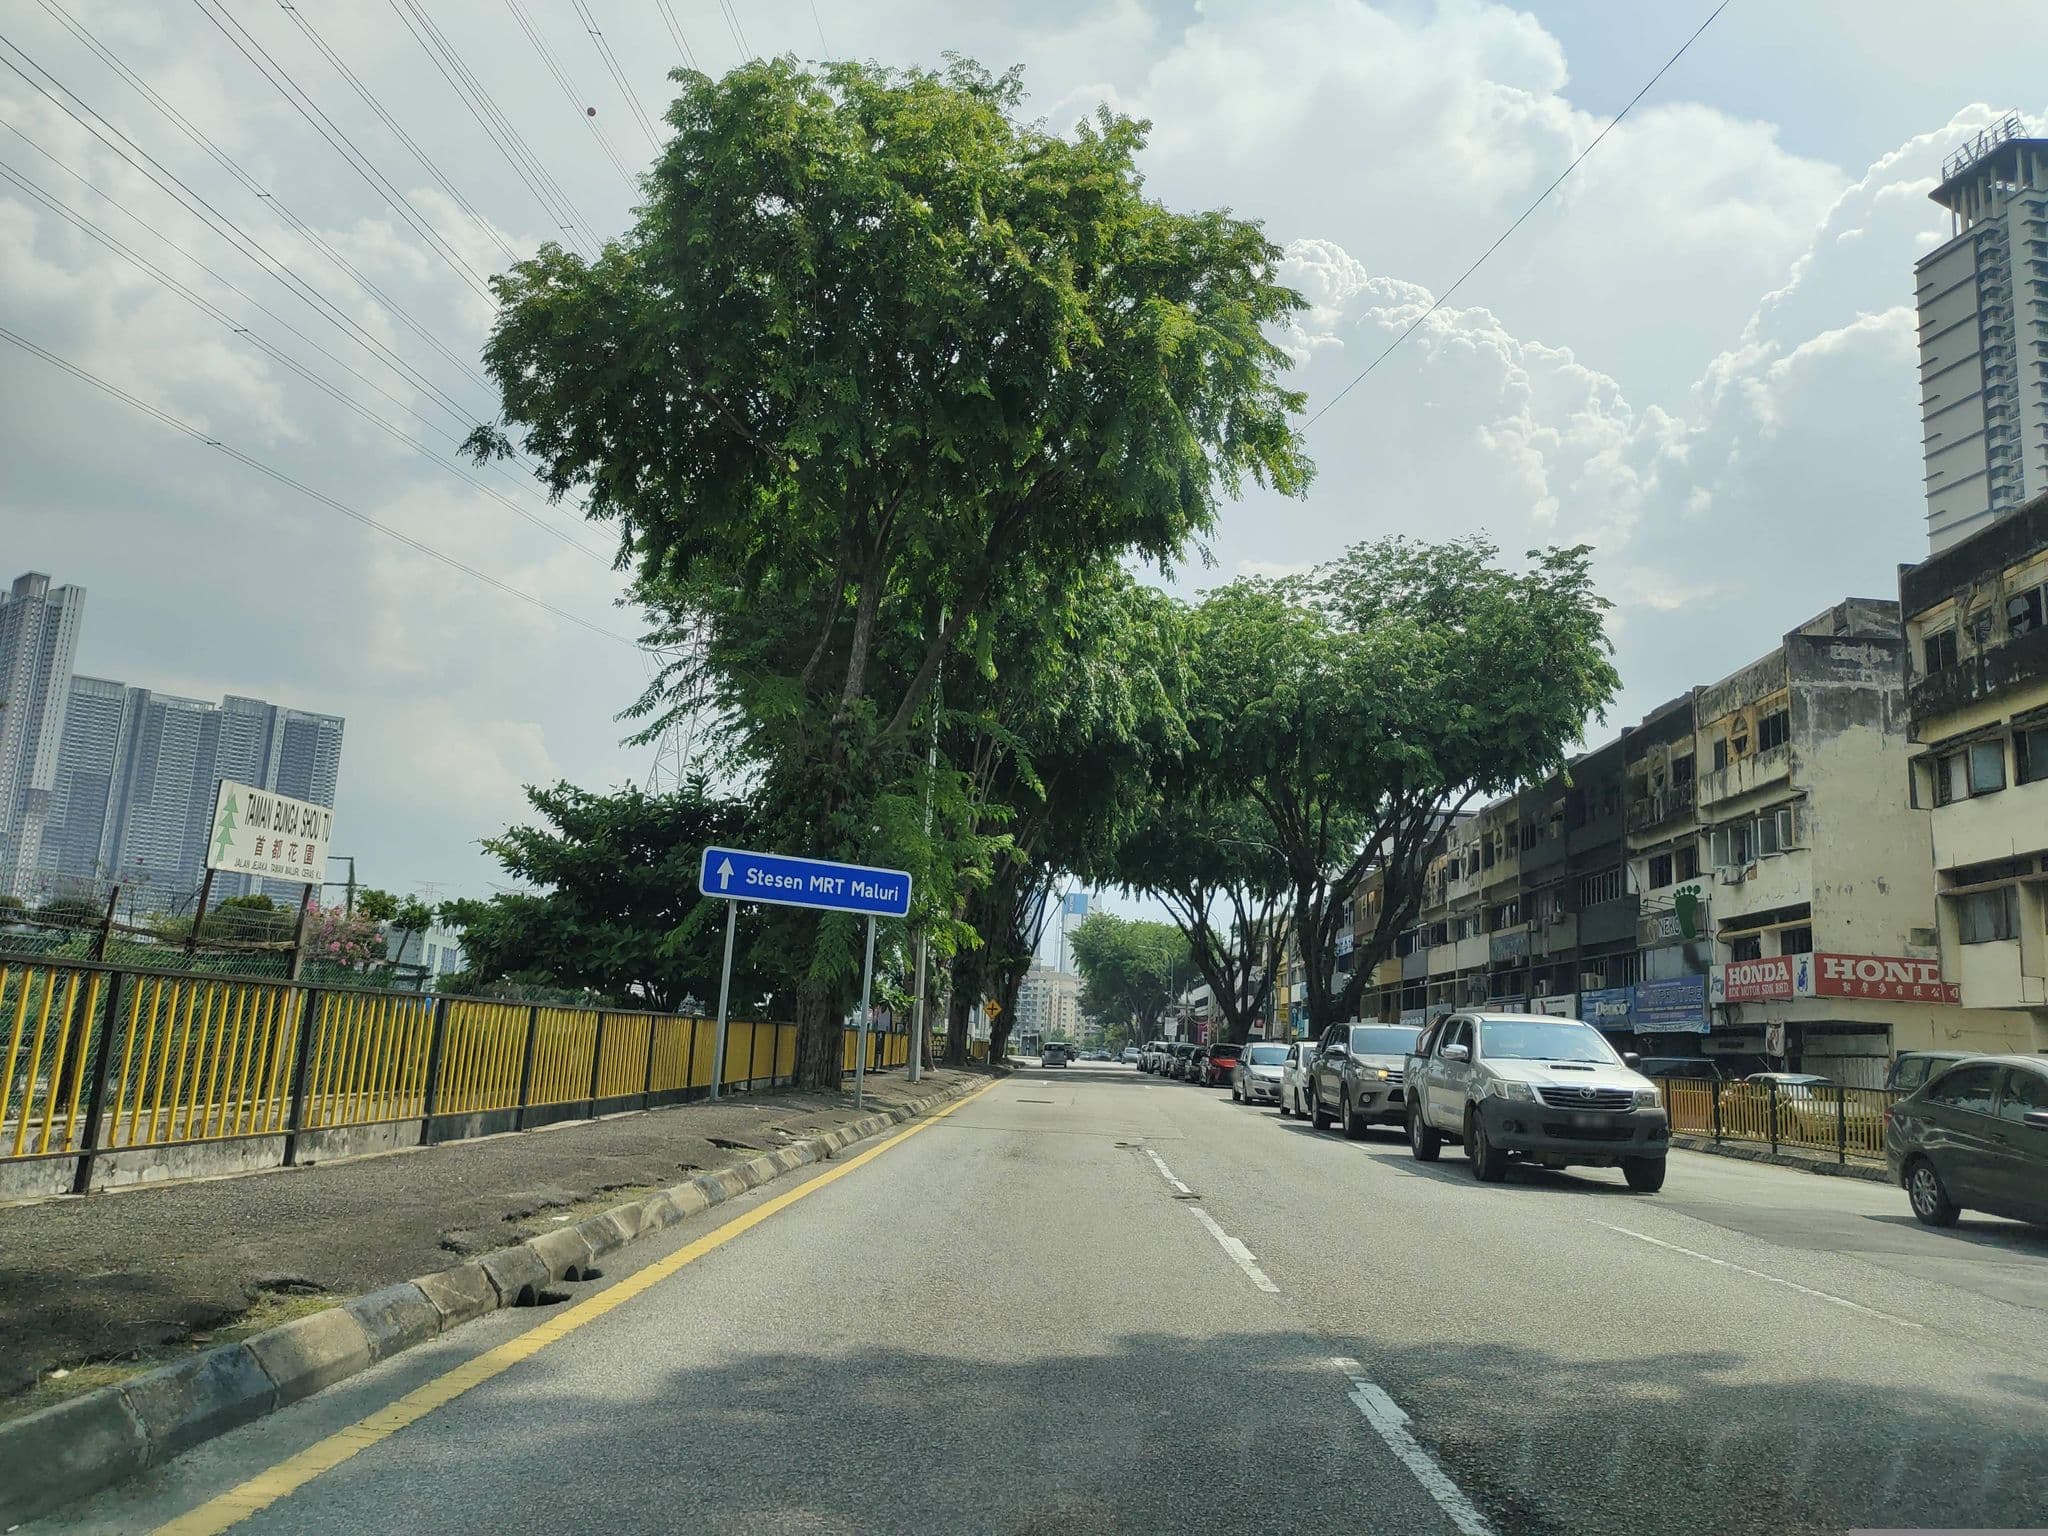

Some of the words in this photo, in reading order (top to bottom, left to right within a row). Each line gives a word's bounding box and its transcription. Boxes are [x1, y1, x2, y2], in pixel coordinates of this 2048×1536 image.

[245, 793, 274, 829] TAMAN
[274, 800, 300, 835] BUNGA
[300, 808, 322, 840] SHOU
[322, 813, 333, 843] TU
[234, 857, 250, 869] JALAN
[254, 834, 316, 865] 首都花園
[746, 867, 803, 891] Stesen
[809, 875, 845, 895] MRT
[851, 880, 899, 902] Maluri
[1728, 961, 1790, 986] HONDA
[1741, 984, 1761, 997] MOTOR
[1761, 983, 1775, 995] SDN
